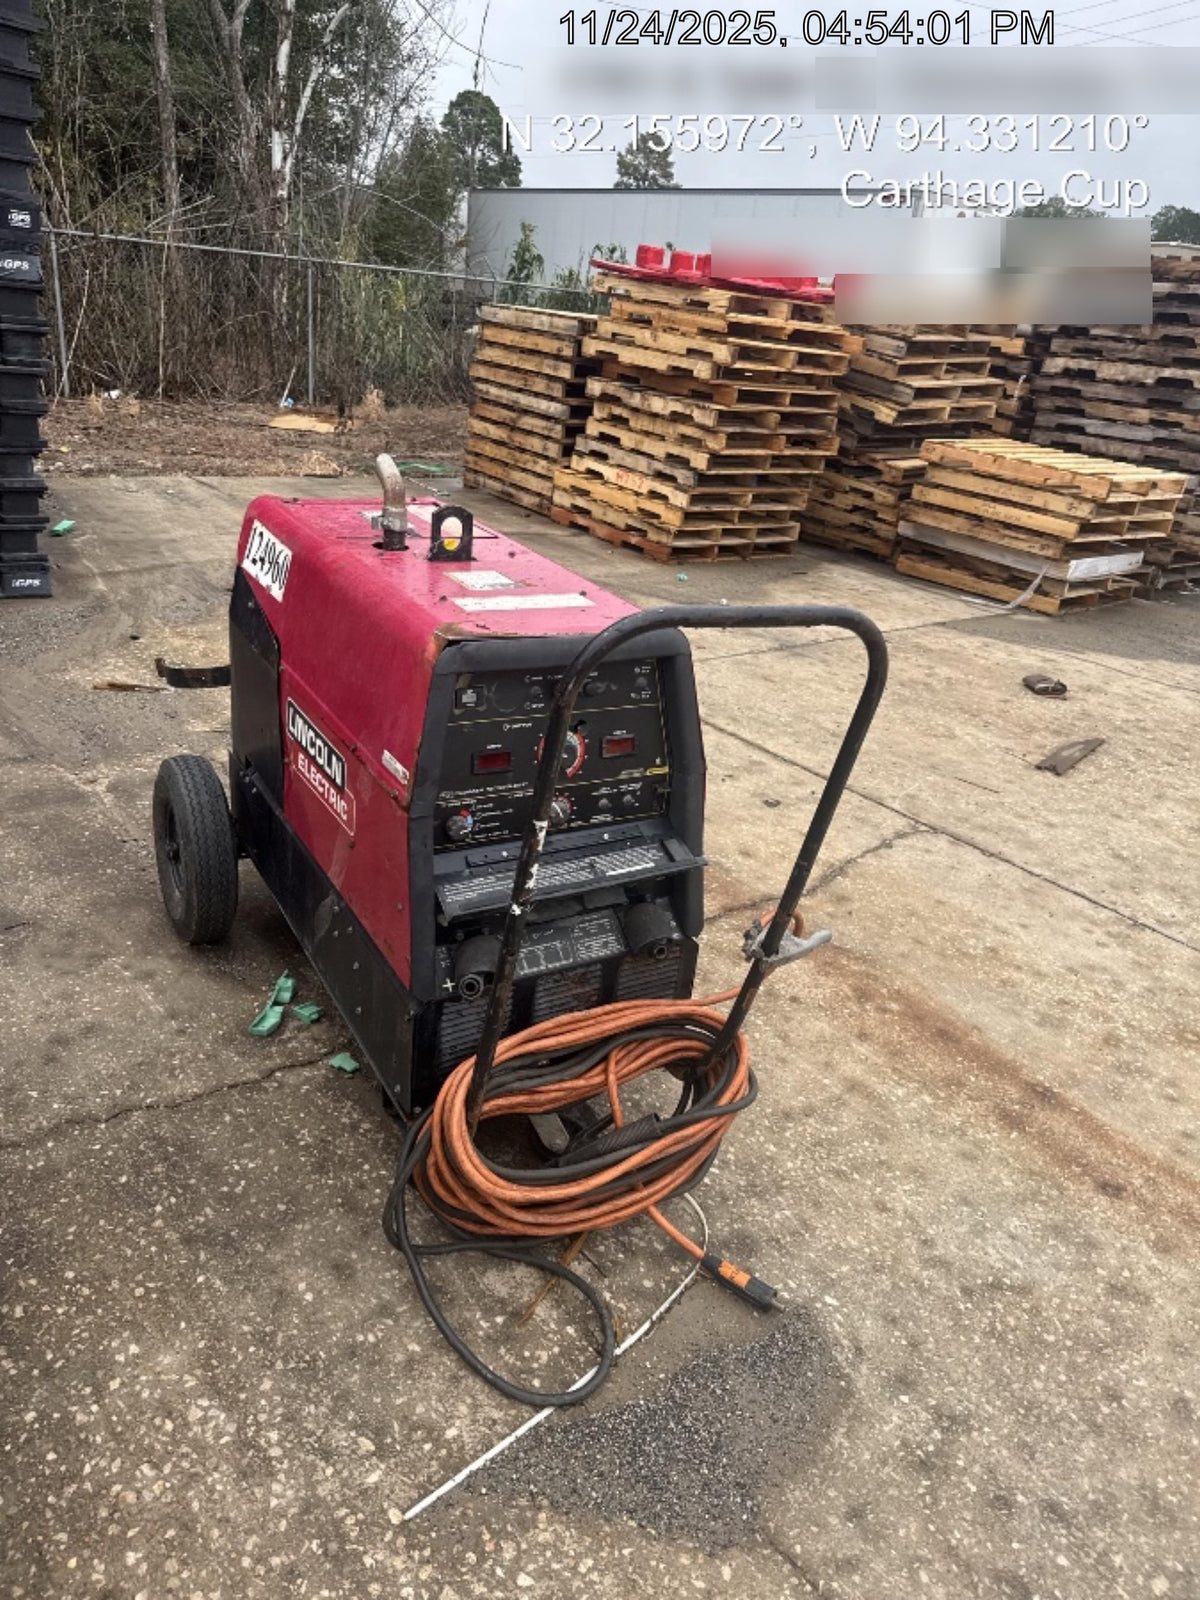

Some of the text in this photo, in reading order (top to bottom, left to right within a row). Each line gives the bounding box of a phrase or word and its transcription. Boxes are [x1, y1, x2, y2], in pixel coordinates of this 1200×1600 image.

[246, 526, 289, 591] 124960
[289, 707, 342, 786] LINCOLN
[297, 753, 347, 821] ELECTRIC
